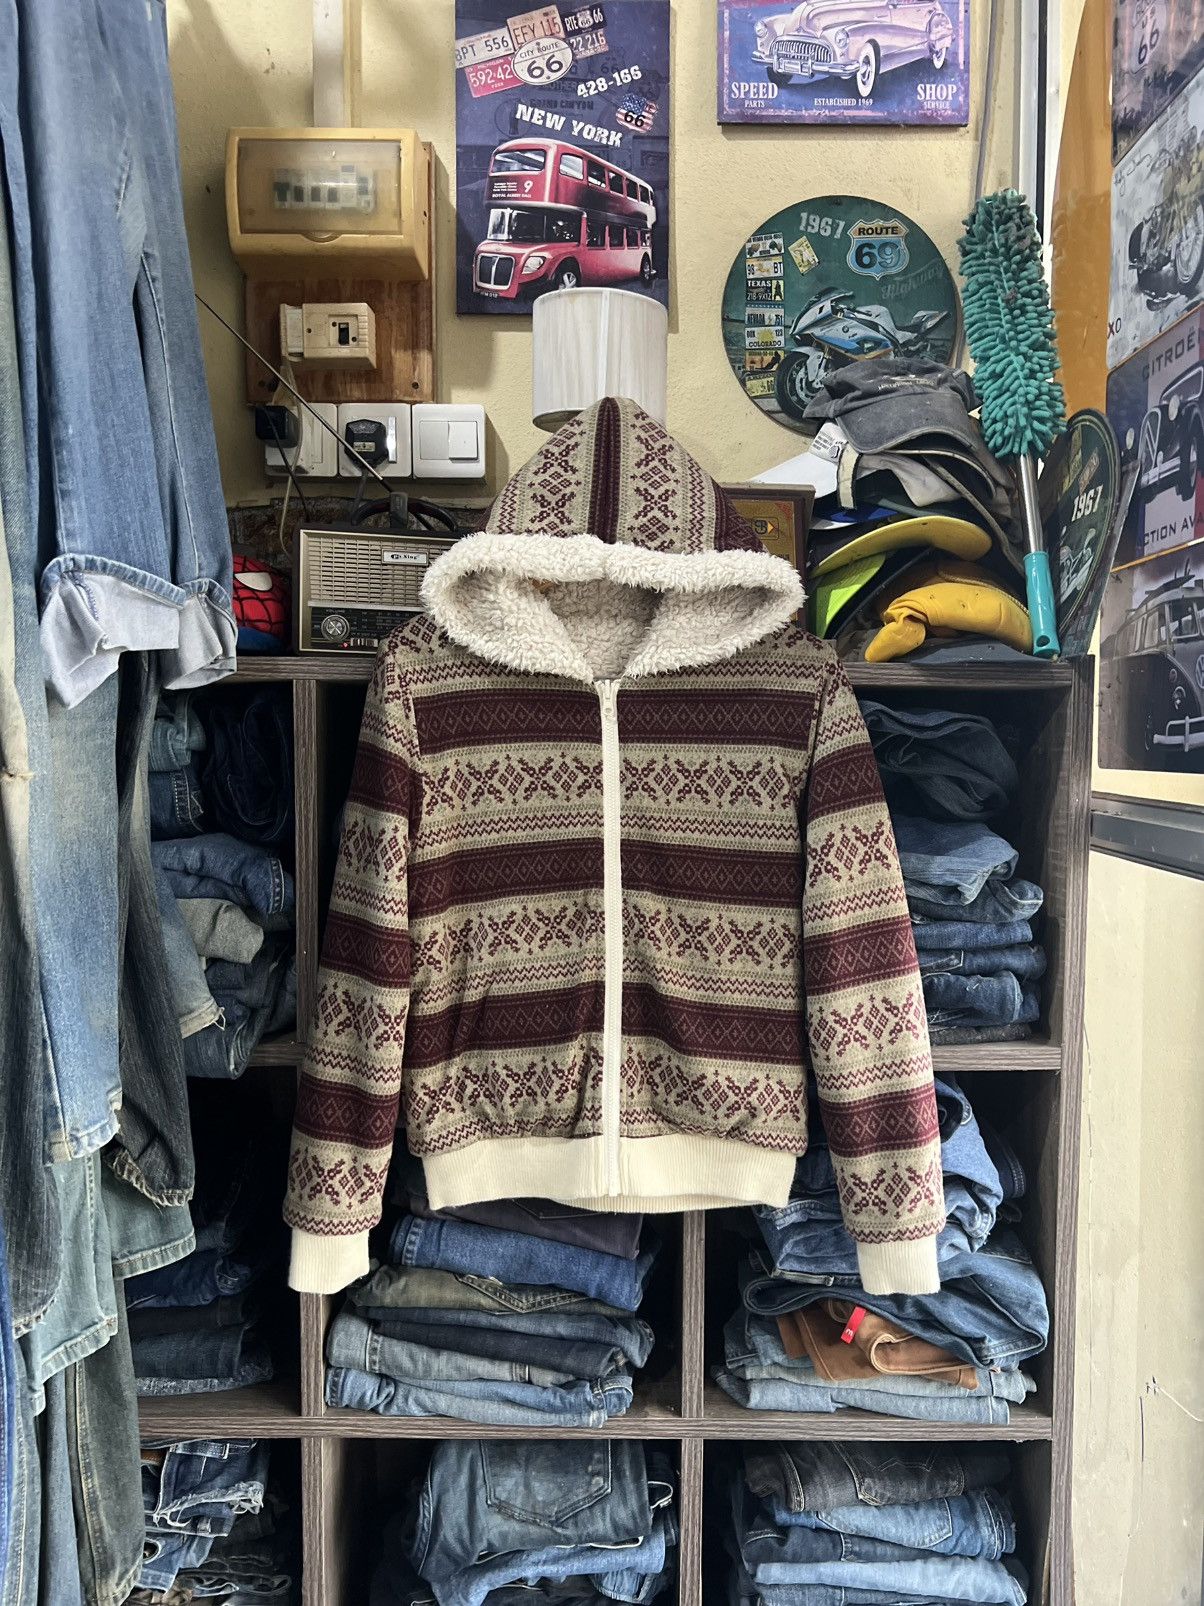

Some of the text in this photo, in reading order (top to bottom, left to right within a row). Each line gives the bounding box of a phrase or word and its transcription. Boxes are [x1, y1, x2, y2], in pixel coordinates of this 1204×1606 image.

[564, 15, 579, 31] RTE
[593, 8, 604, 23] 66
[484, 36, 509, 52] 556
[585, 31, 606, 49] 216
[1137, 19, 1160, 65] 66
[519, 49, 534, 59] CITY
[526, 54, 563, 79] 66
[577, 65, 642, 98] 428-166
[731, 81, 957, 100] SPEED SHOP
[744, 99, 765, 108] PARTS
[814, 97, 857, 106] ESTABLISHED
[515, 103, 623, 148] NEW YORK
[623, 110, 646, 128] 66
[523, 180, 534, 193] 9
[800, 212, 846, 239] 1967
[857, 226, 899, 236] ROUTE
[854, 241, 901, 269] 69
[748, 340, 782, 348] COLORADO
[1071, 484, 1104, 522] 1967
